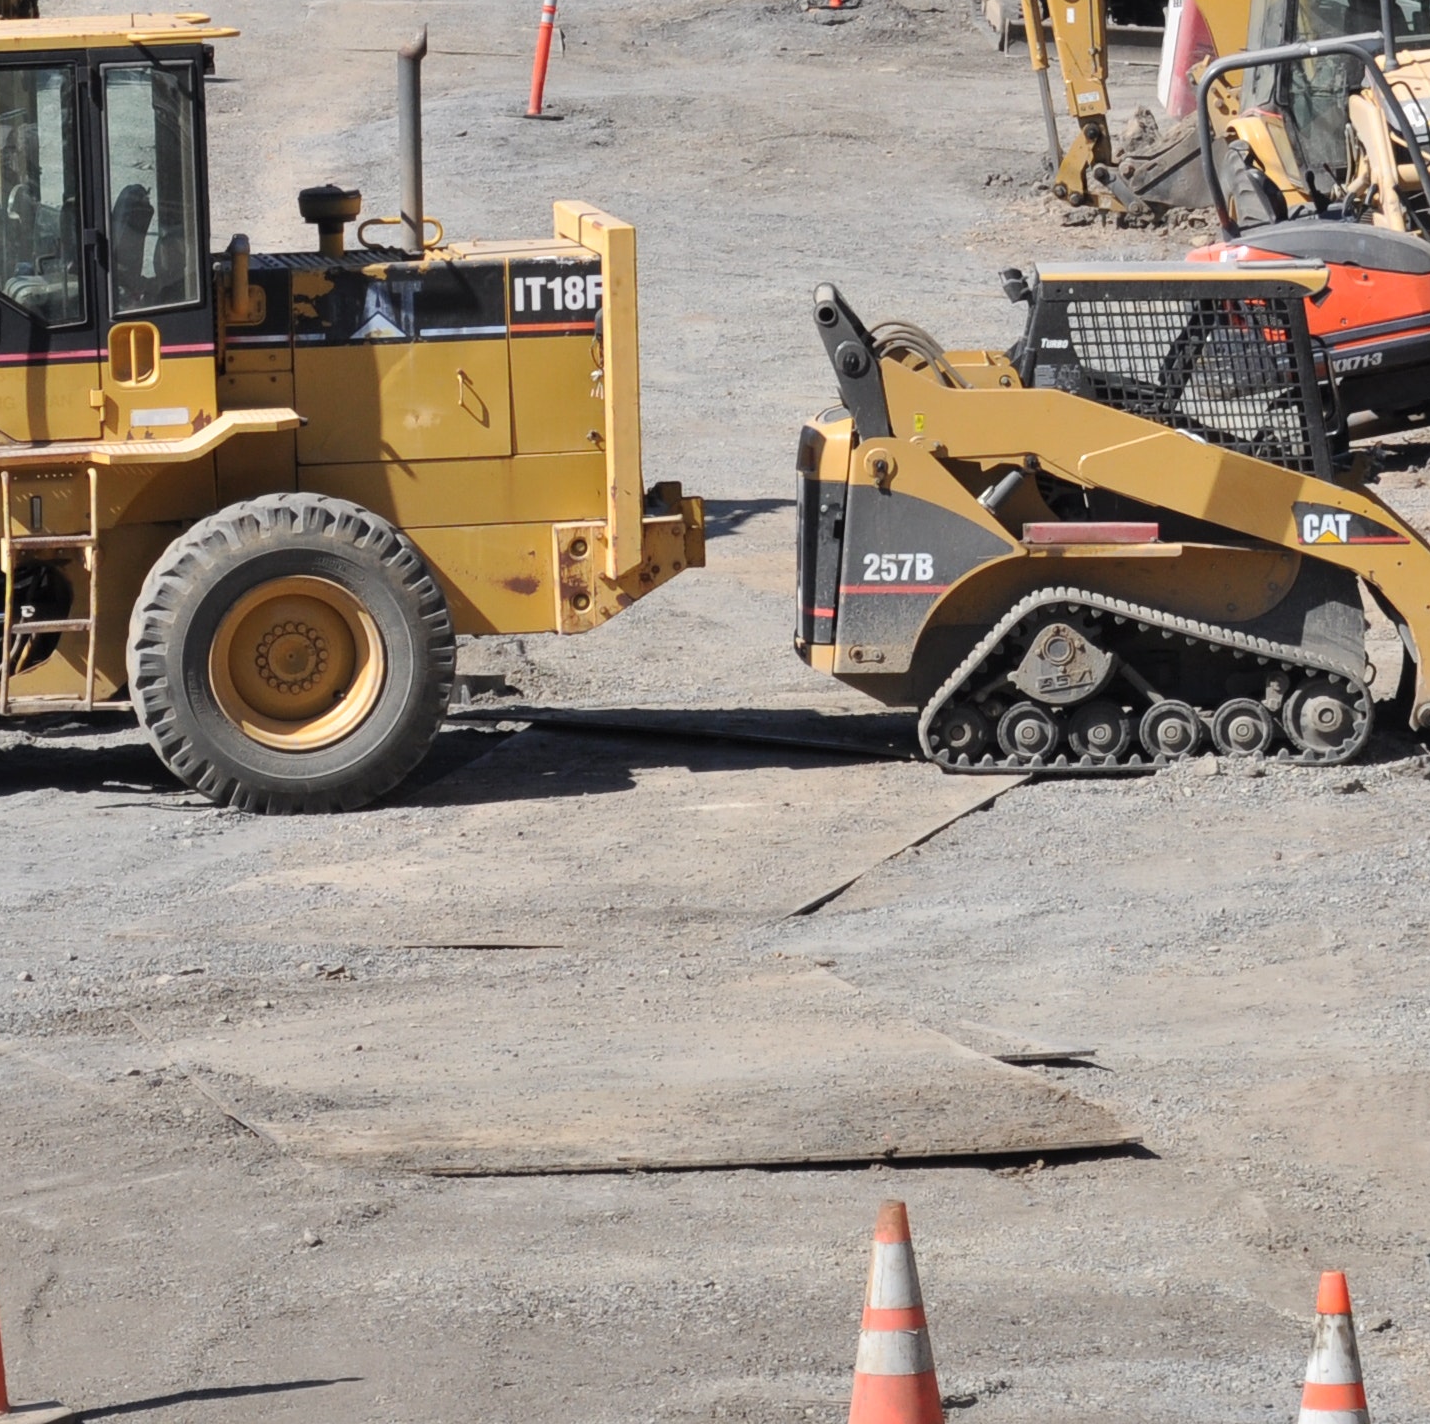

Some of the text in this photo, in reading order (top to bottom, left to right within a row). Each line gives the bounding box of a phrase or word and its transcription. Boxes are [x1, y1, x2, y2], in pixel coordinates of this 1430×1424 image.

[513, 274, 603, 312] IT18F
[1302, 513, 1352, 544] CAT
[862, 552, 935, 582] 257B
